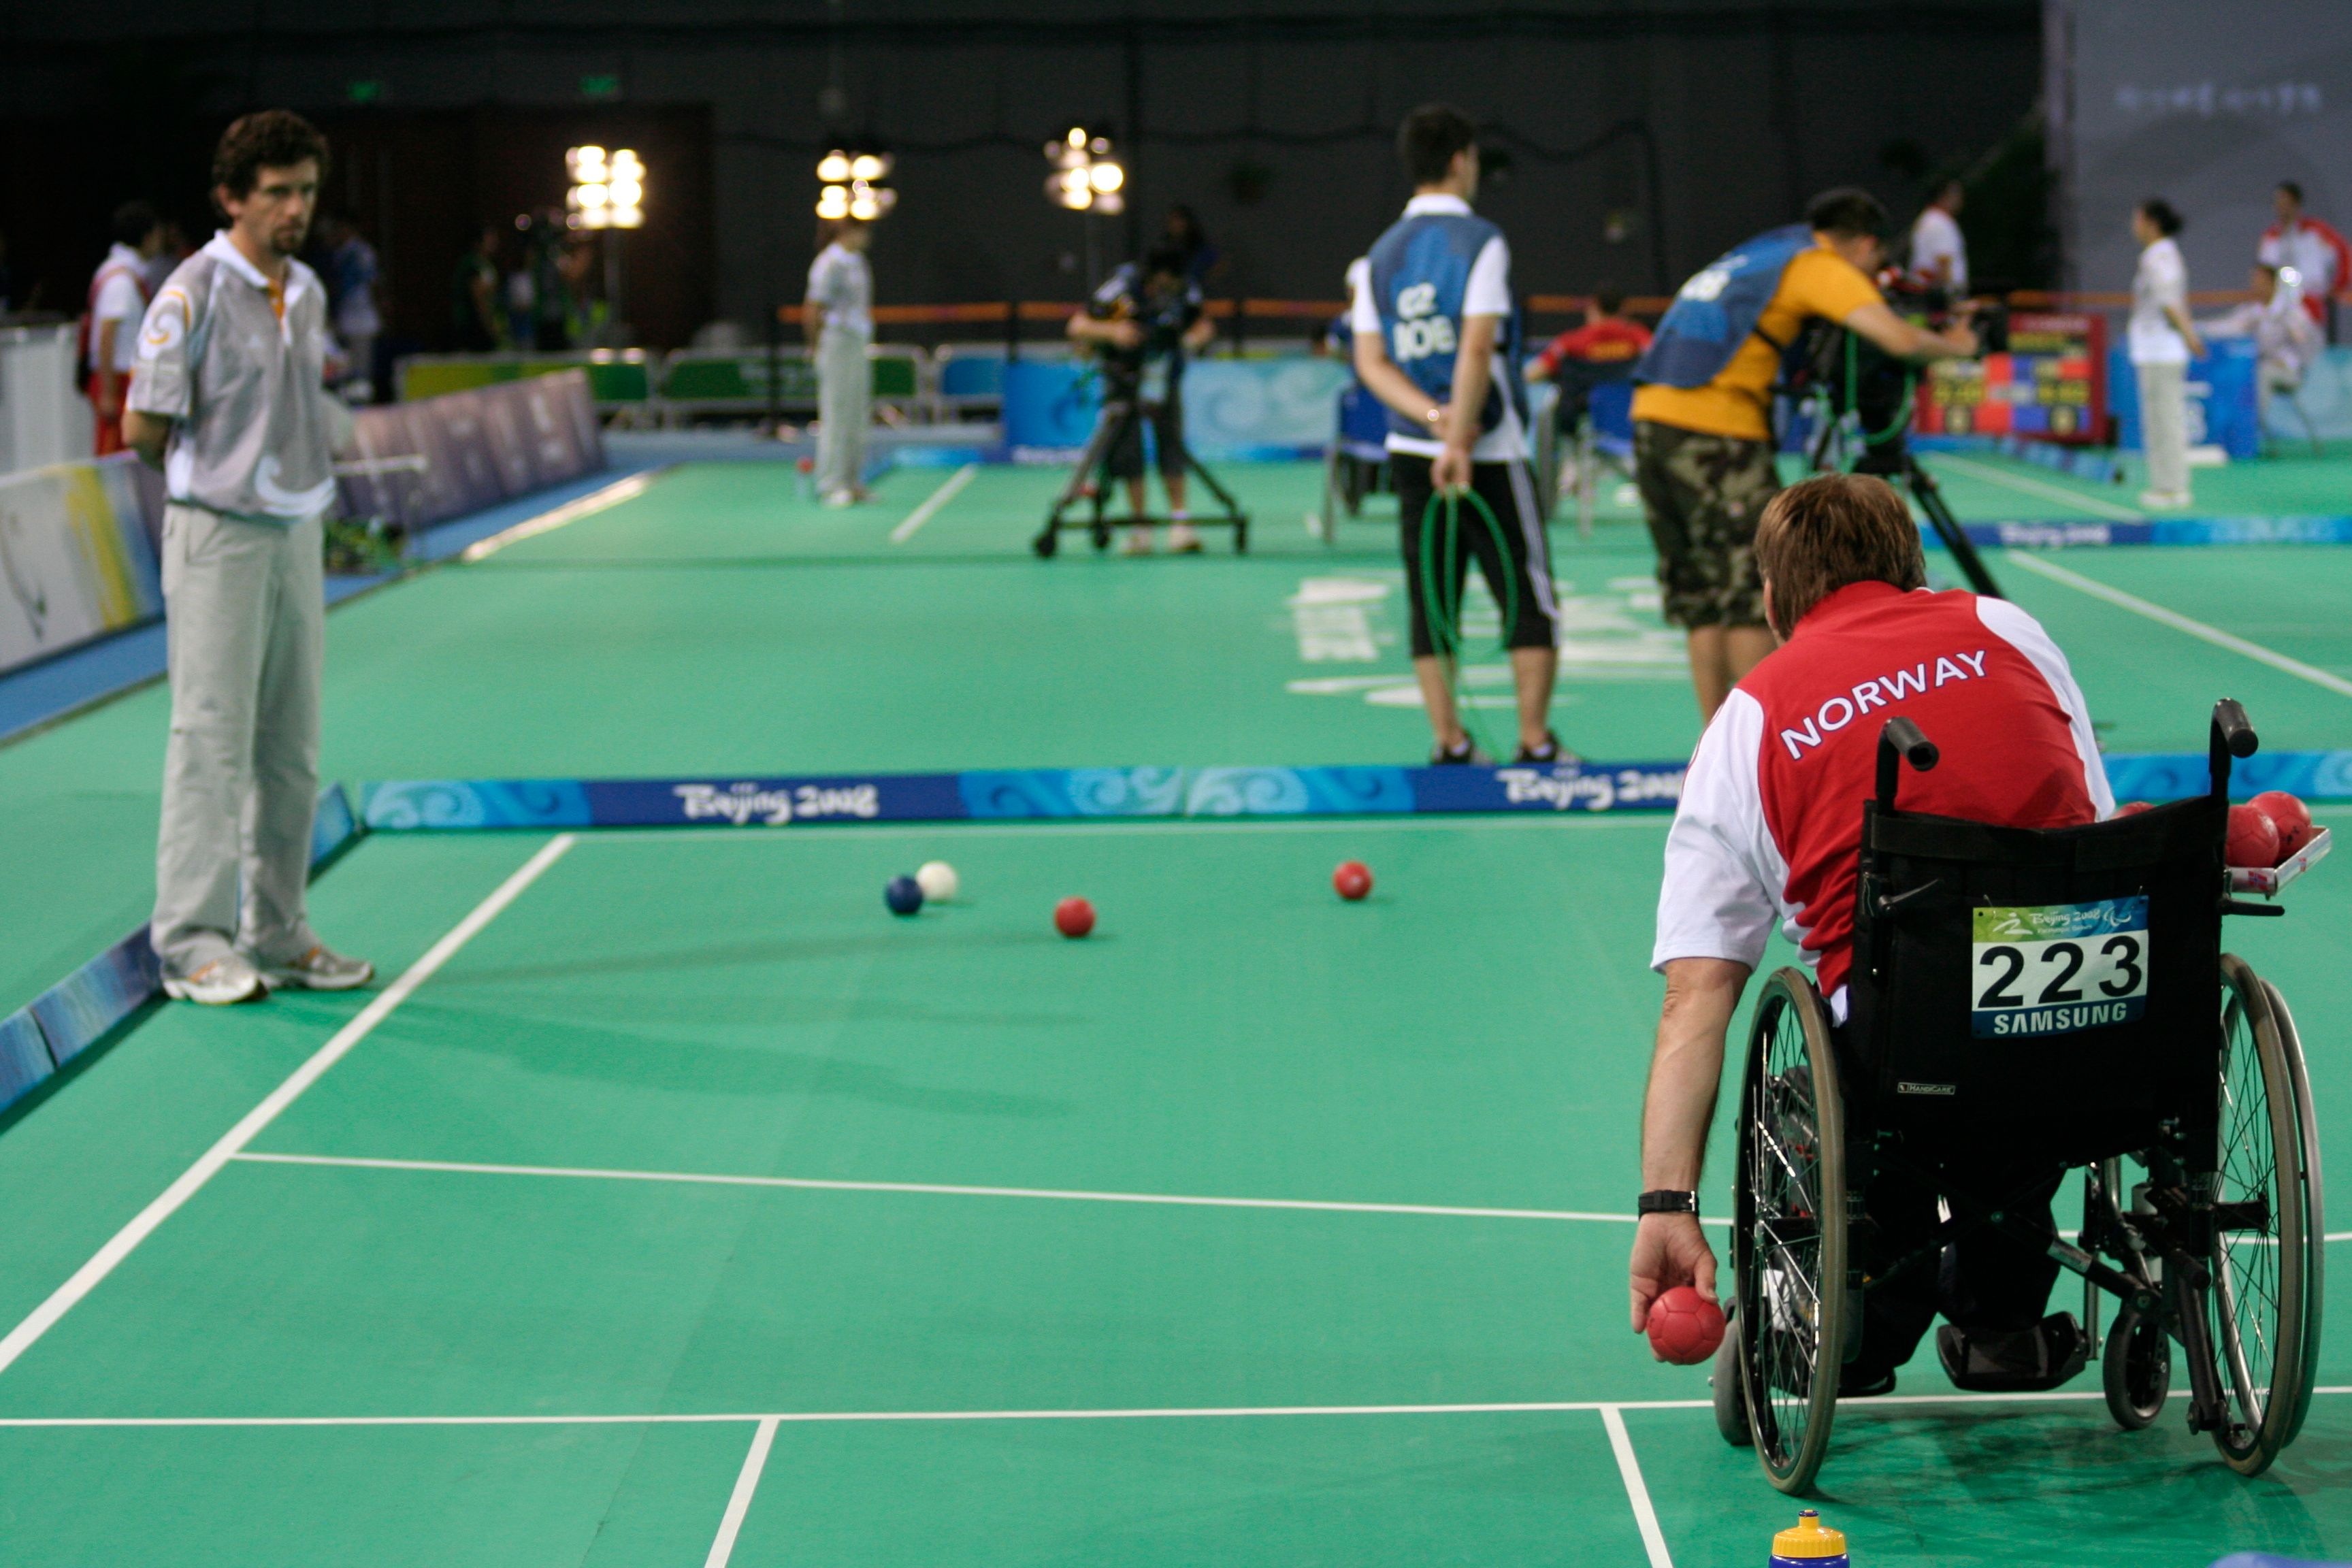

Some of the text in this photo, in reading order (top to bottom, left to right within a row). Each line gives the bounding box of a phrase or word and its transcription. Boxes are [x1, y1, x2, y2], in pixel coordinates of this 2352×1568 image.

[1780, 650, 1986, 761] NORWAY
[674, 783, 880, 826] Beijing 2008
[1495, 766, 1615, 811] Beijing
[2029, 909, 2101, 926] Beijing 2008
[1978, 935, 2142, 1009] 223
[1994, 1002, 2127, 1034] SAMSUNG
